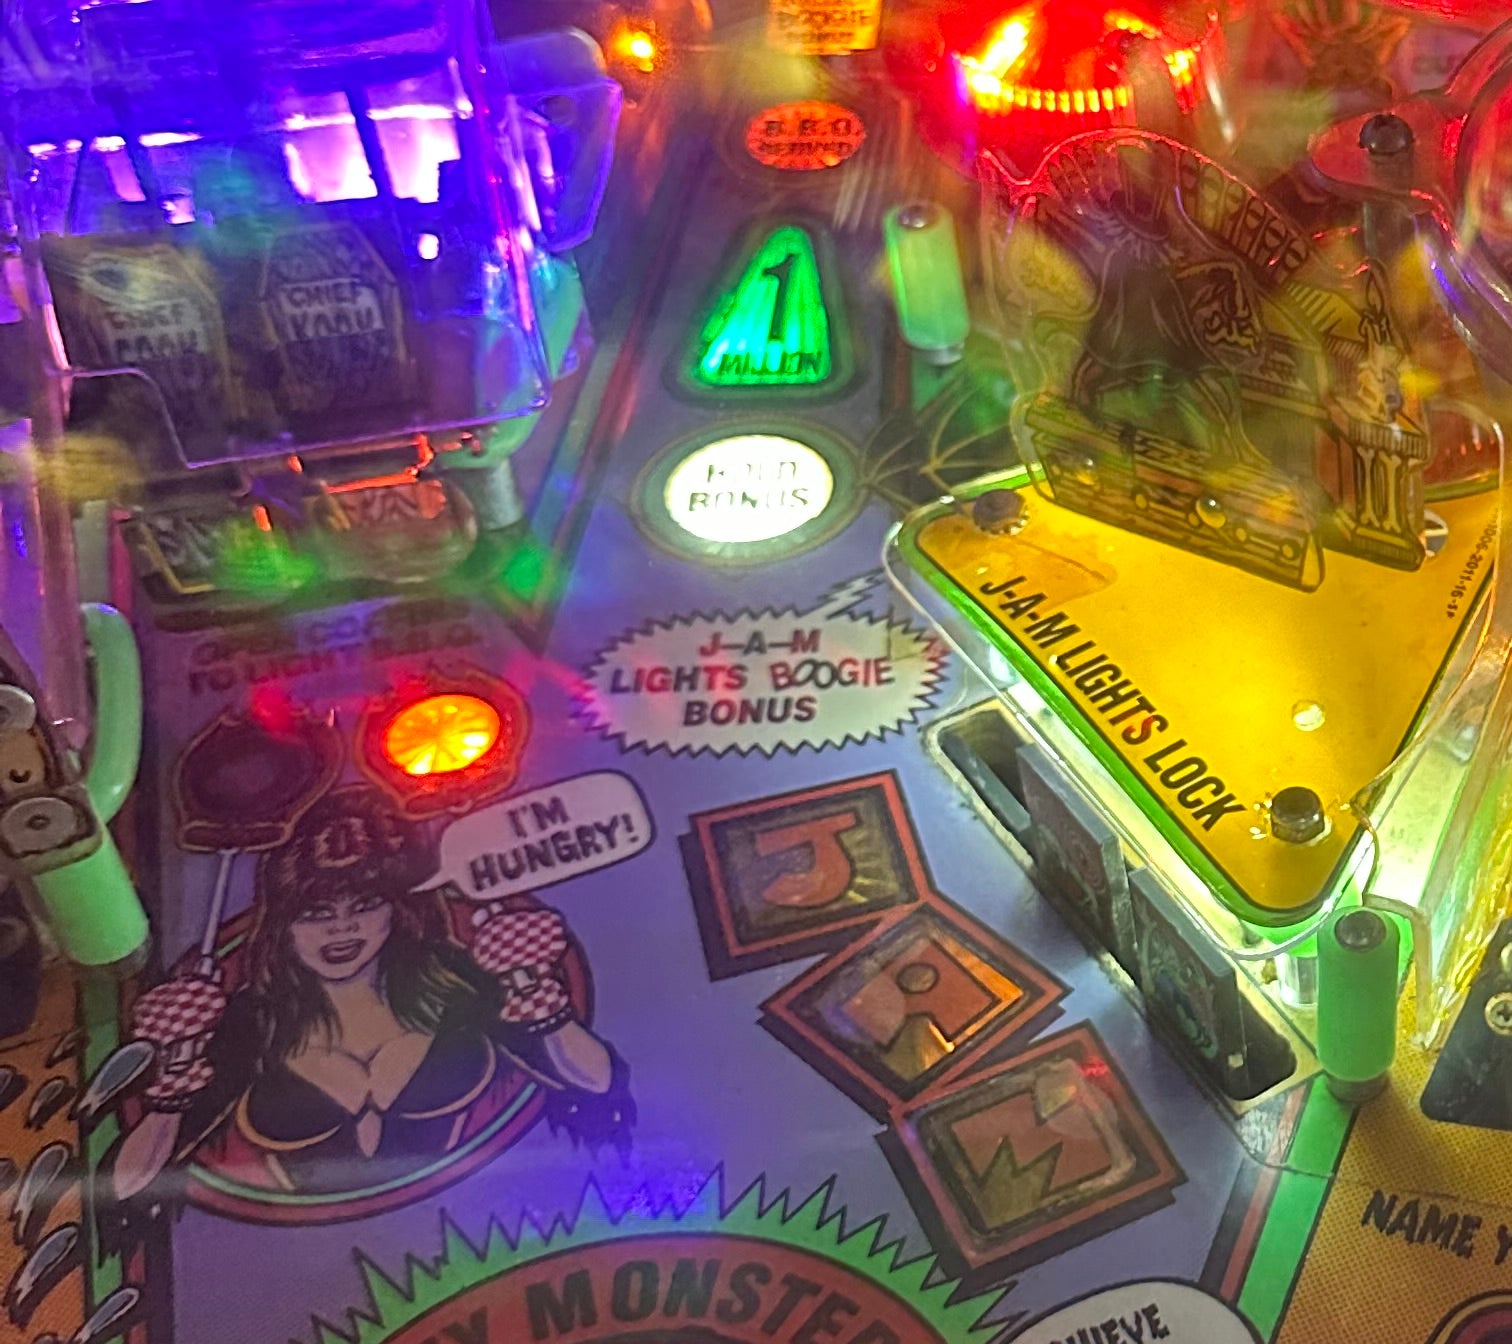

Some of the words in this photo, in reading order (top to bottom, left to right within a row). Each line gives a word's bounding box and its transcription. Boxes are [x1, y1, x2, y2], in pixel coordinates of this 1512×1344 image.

[761, 252, 801, 341] 1
[717, 351, 824, 376] MILLION
[688, 487, 810, 512] BONUS
[609, 663, 751, 695] LIGHTS
[769, 657, 896, 691] BOOGIE
[980, 575, 1082, 650] J-A-M
[1053, 639, 1169, 745] LIGHTS
[1142, 738, 1248, 832] LOCK
[681, 695, 819, 728] BONUS
[506, 795, 571, 839] I'M
[468, 812, 640, 893] HUNGRY!
[754, 811, 862, 908] J
[1360, 1187, 1482, 1260] NAME
